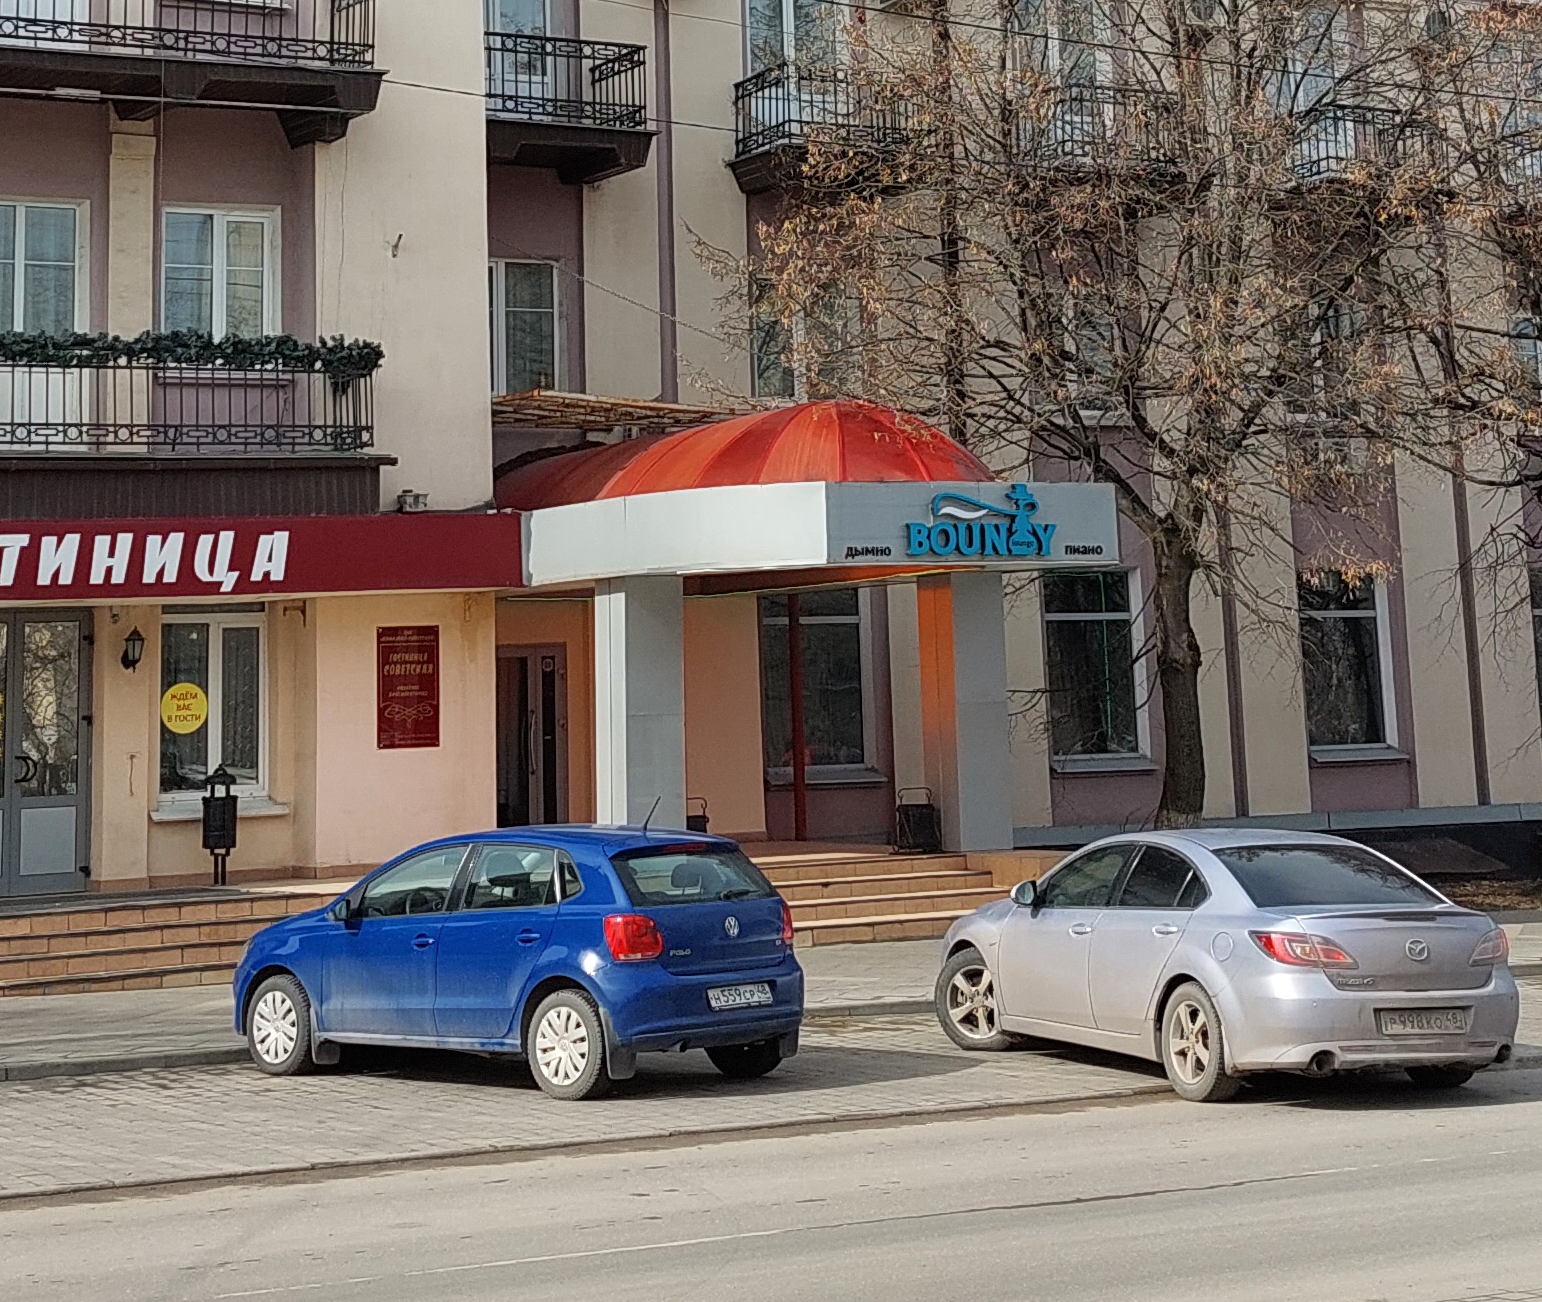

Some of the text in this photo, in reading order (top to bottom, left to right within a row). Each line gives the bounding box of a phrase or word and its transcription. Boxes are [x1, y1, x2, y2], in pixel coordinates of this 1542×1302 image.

[1011, 538, 1035, 549] lounge
[383, 663, 434, 676] СОВЕТСКАЯ
[170, 691, 198, 702] ЖДЁМ
[176, 703, 193, 711] ВАС
[167, 714, 201, 722] В ГОСТИ
